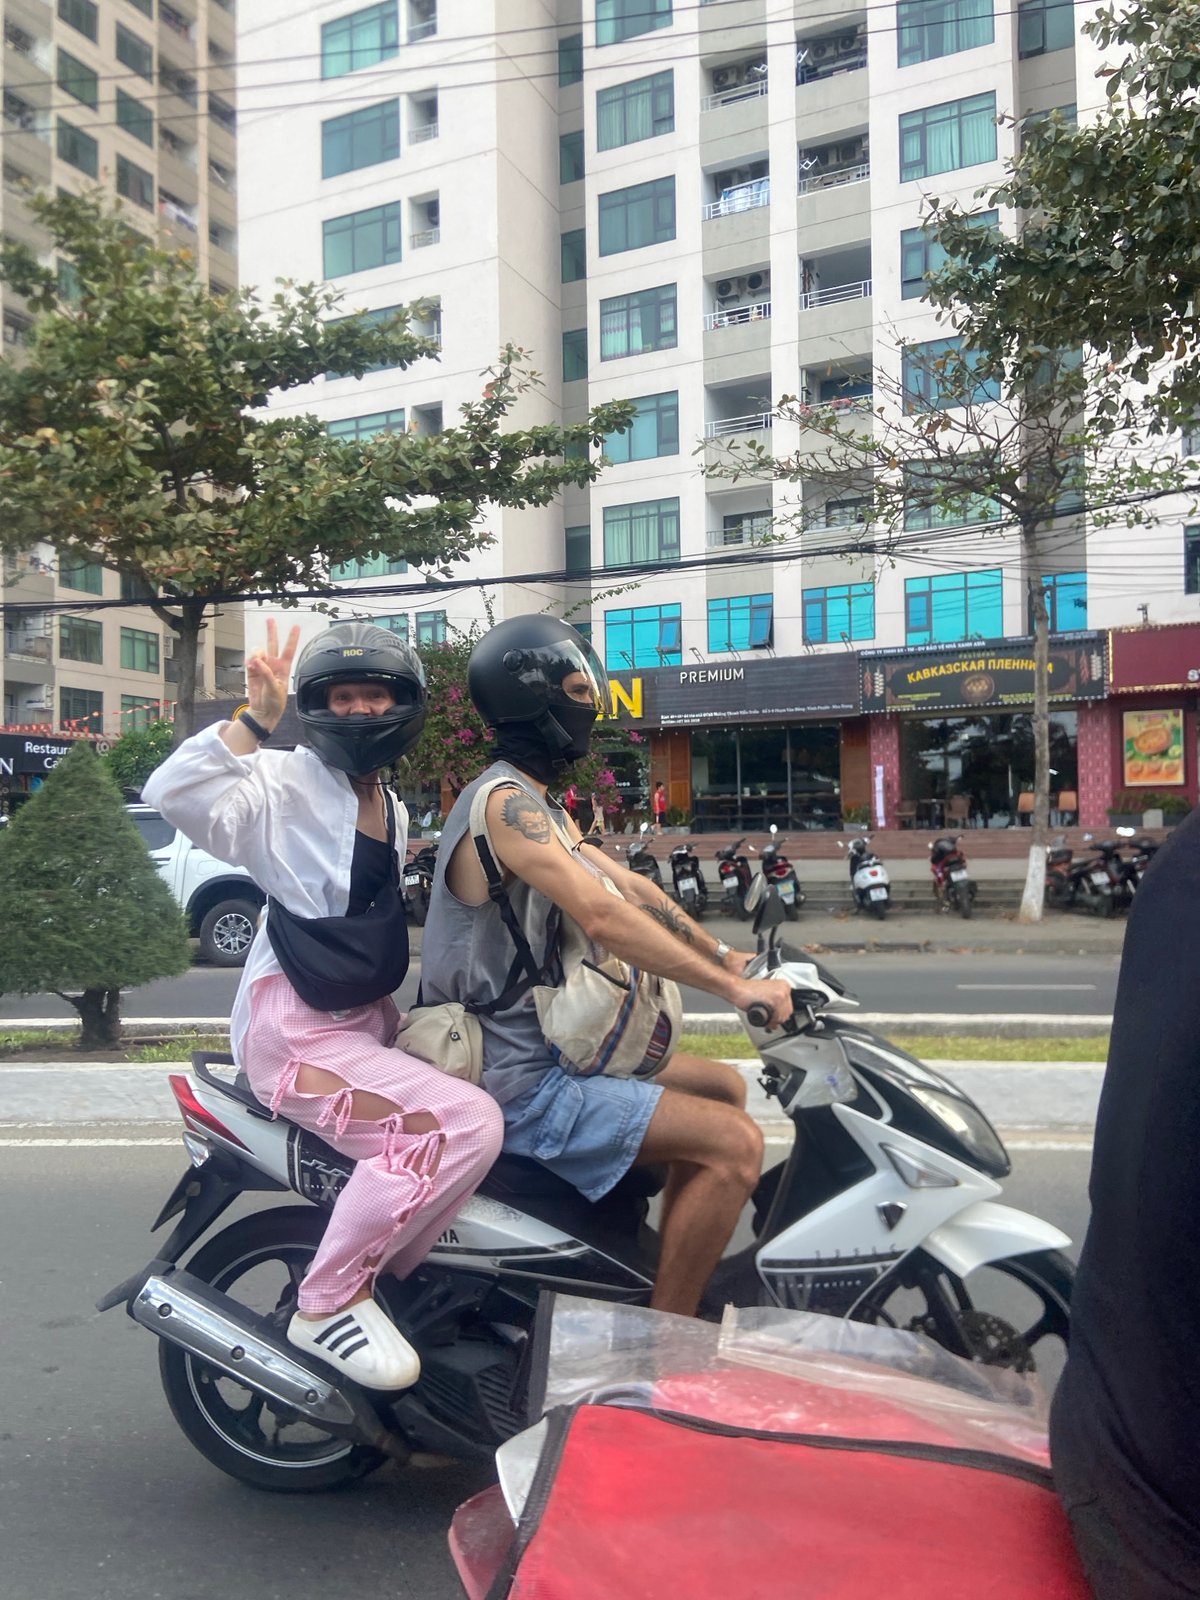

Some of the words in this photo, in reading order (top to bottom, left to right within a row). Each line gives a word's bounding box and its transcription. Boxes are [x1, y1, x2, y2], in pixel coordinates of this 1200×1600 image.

[680, 667, 744, 684] PREMIUM
[907, 660, 986, 684] КАВКАЗСКАЯ
[43, 757, 63, 769] Ca
